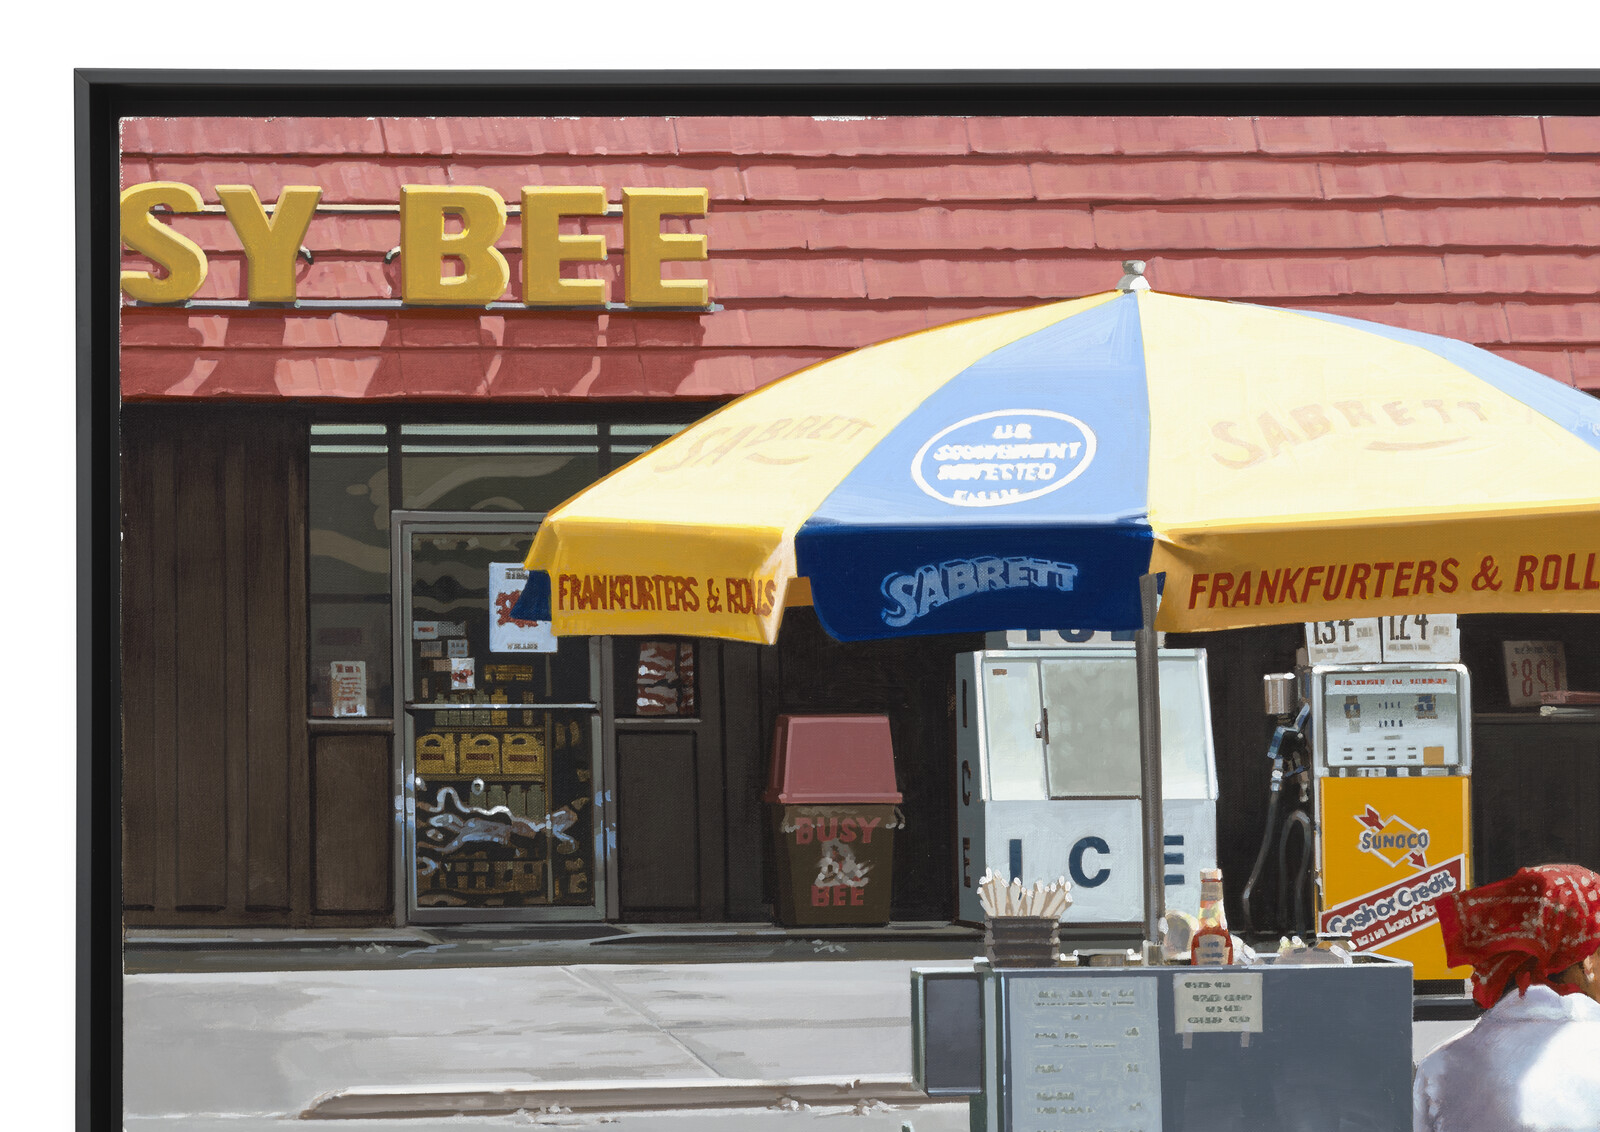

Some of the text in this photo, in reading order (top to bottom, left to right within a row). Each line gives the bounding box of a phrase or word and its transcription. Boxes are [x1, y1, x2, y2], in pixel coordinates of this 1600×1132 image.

[120, 181, 710, 308] SY BEE
[1210, 399, 1489, 470] SABRETT
[558, 574, 777, 617] FRANKFURTERS & ROLLS
[881, 556, 1078, 627] SABRETT
[1188, 557, 1459, 610] FRANKFURTERS
[1471, 555, 1502, 592] &
[796, 816, 881, 845] BUSY
[1361, 832, 1429, 850] SUNOCO
[1009, 835, 1185, 889] ICE
[811, 884, 865, 907] BEE
[1377, 896, 1396, 917] or
[1398, 871, 1455, 907] Credit
